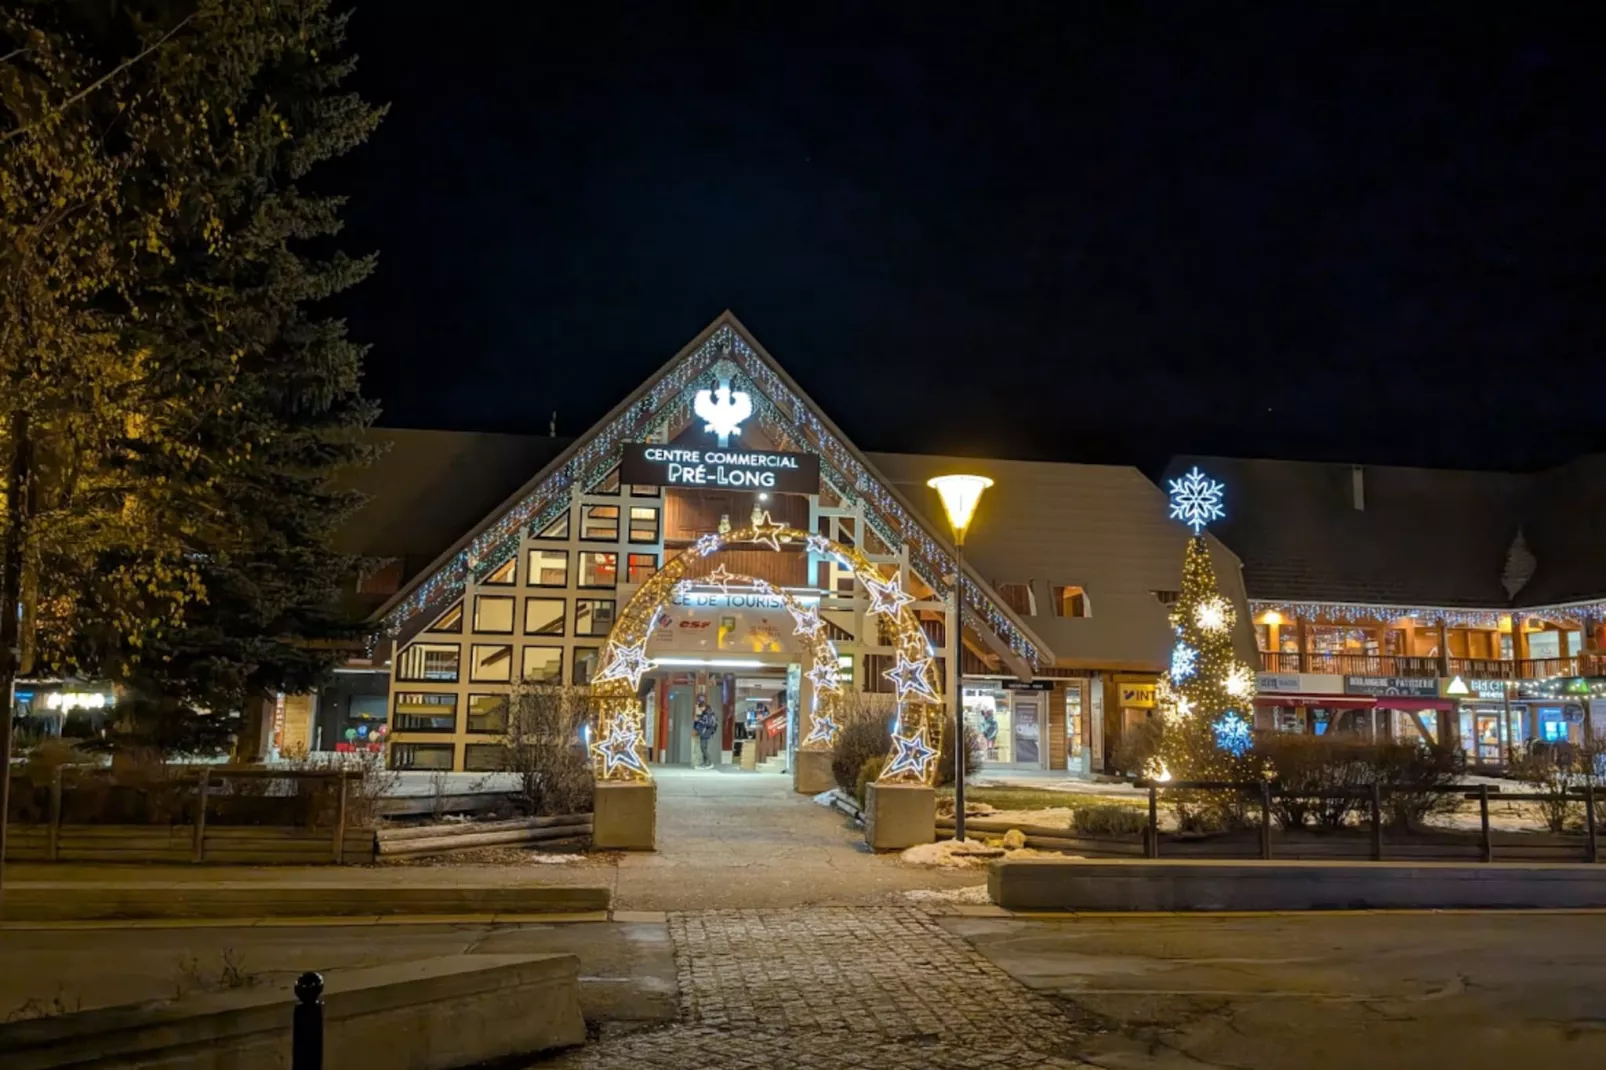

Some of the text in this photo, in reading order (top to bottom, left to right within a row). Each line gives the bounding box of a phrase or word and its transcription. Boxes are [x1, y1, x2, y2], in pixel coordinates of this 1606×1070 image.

[644, 448, 799, 469] CENTRE COMMERCIAL
[697, 595, 717, 607] DE
